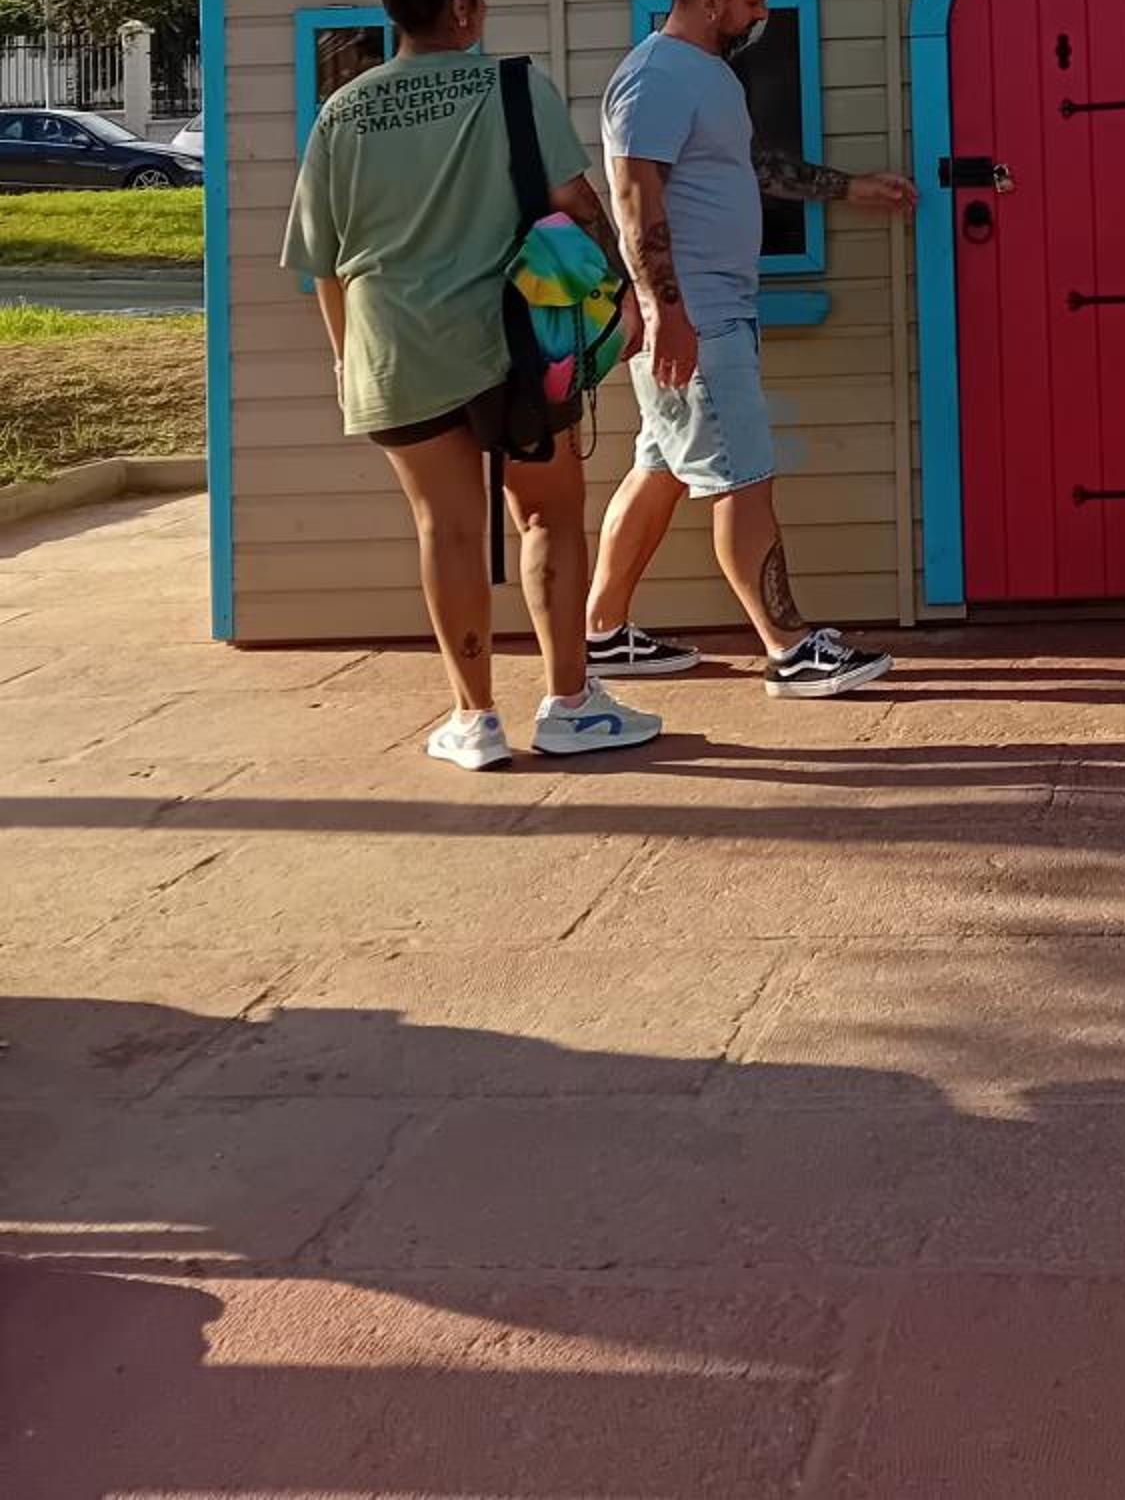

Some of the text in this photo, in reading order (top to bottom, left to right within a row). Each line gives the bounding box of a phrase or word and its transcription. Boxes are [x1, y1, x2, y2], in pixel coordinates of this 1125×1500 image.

[376, 81, 391, 97] N
[395, 72, 447, 95] ROLL
[355, 102, 455, 135] SMASHED
